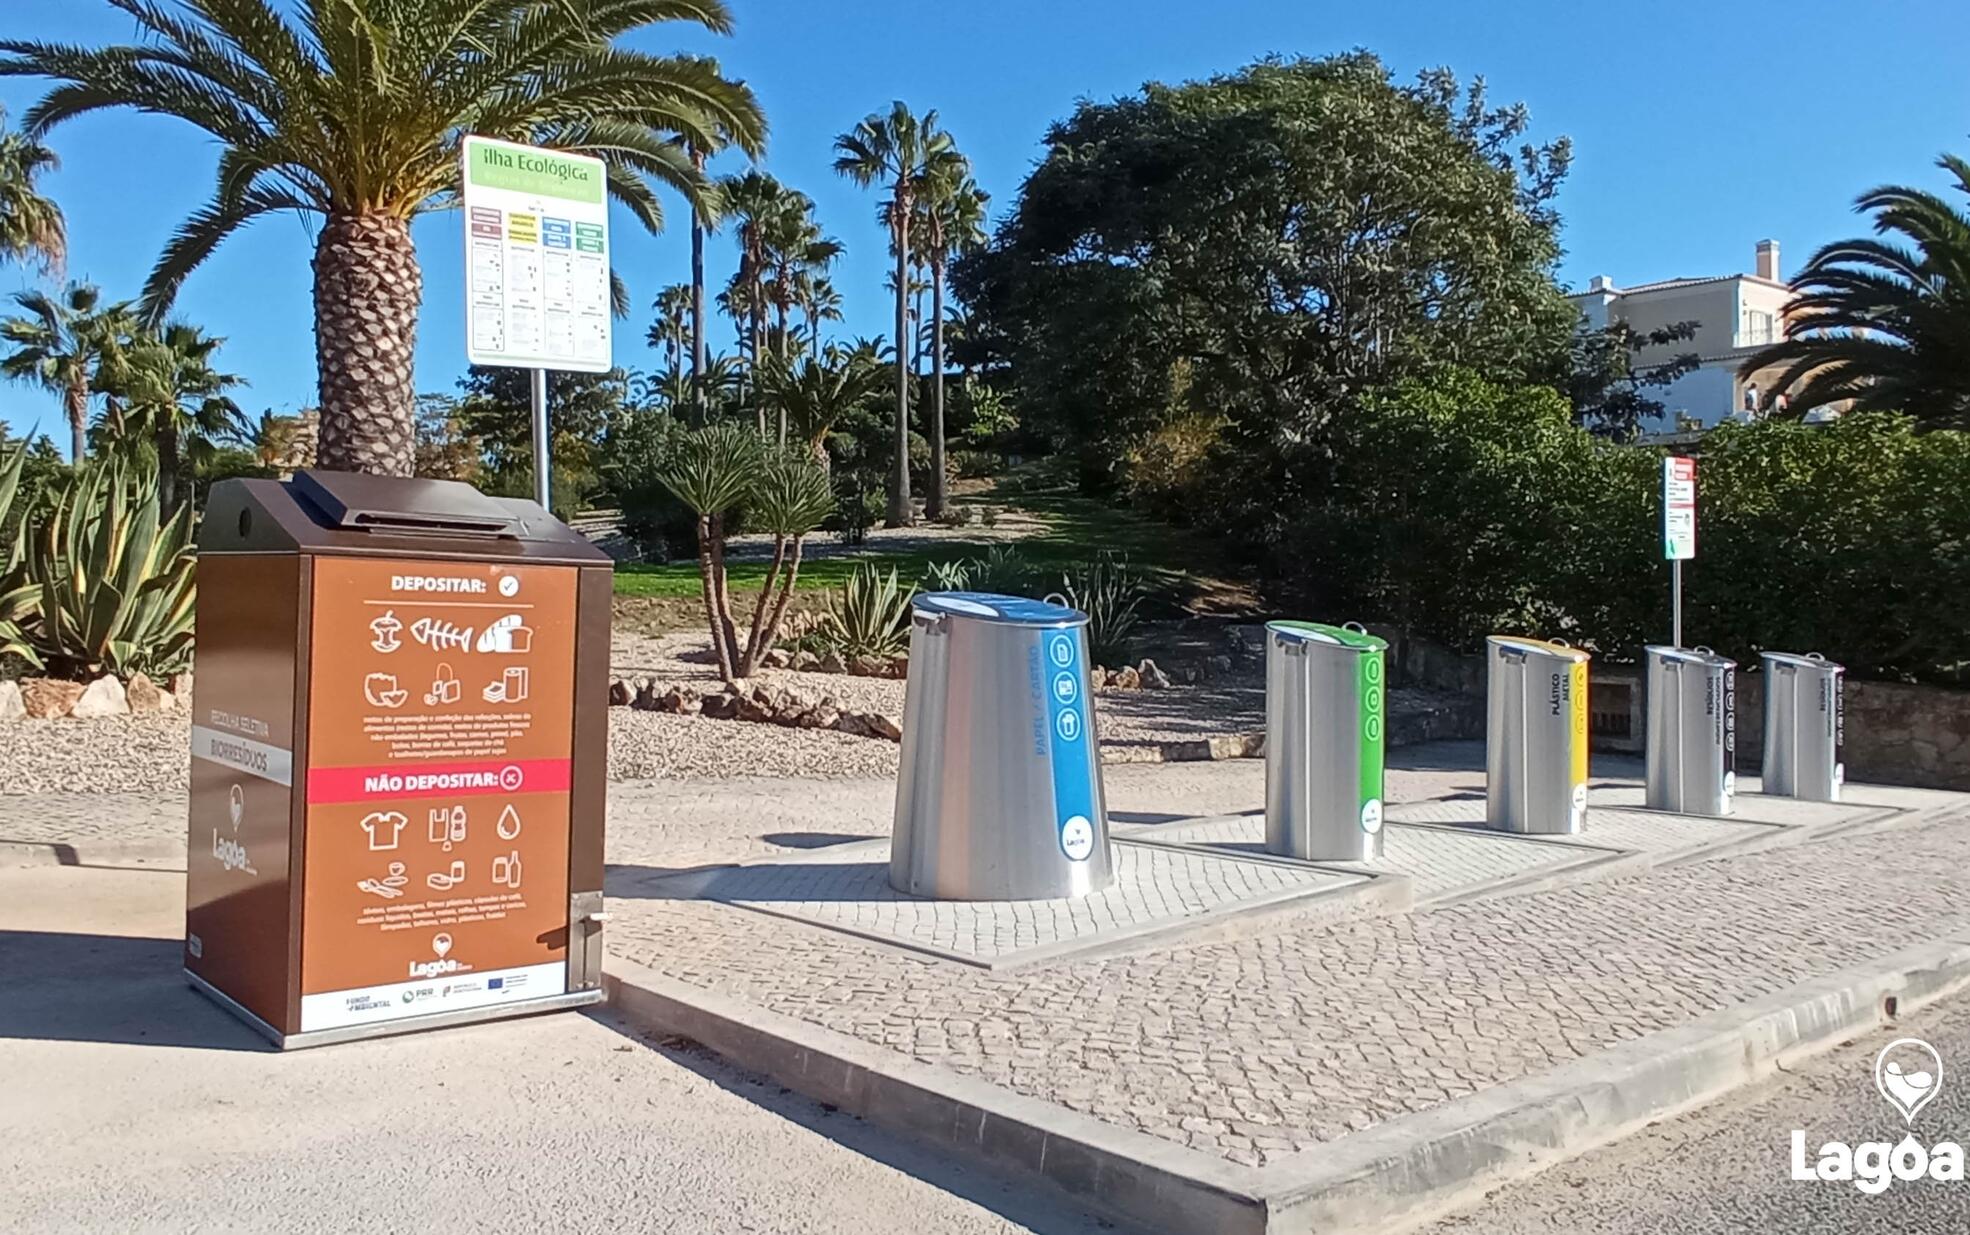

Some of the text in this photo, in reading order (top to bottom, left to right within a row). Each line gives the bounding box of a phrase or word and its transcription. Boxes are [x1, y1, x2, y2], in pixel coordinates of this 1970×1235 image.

[518, 154, 588, 181] Ecológica
[391, 575, 487, 593] DEPOSITAR:
[1550, 673, 1560, 716] PLÁSTICO
[365, 772, 499, 792] NÃO DEPOSITAR:
[213, 828, 245, 871] Lagoa
[409, 960, 456, 977] Lagoa
